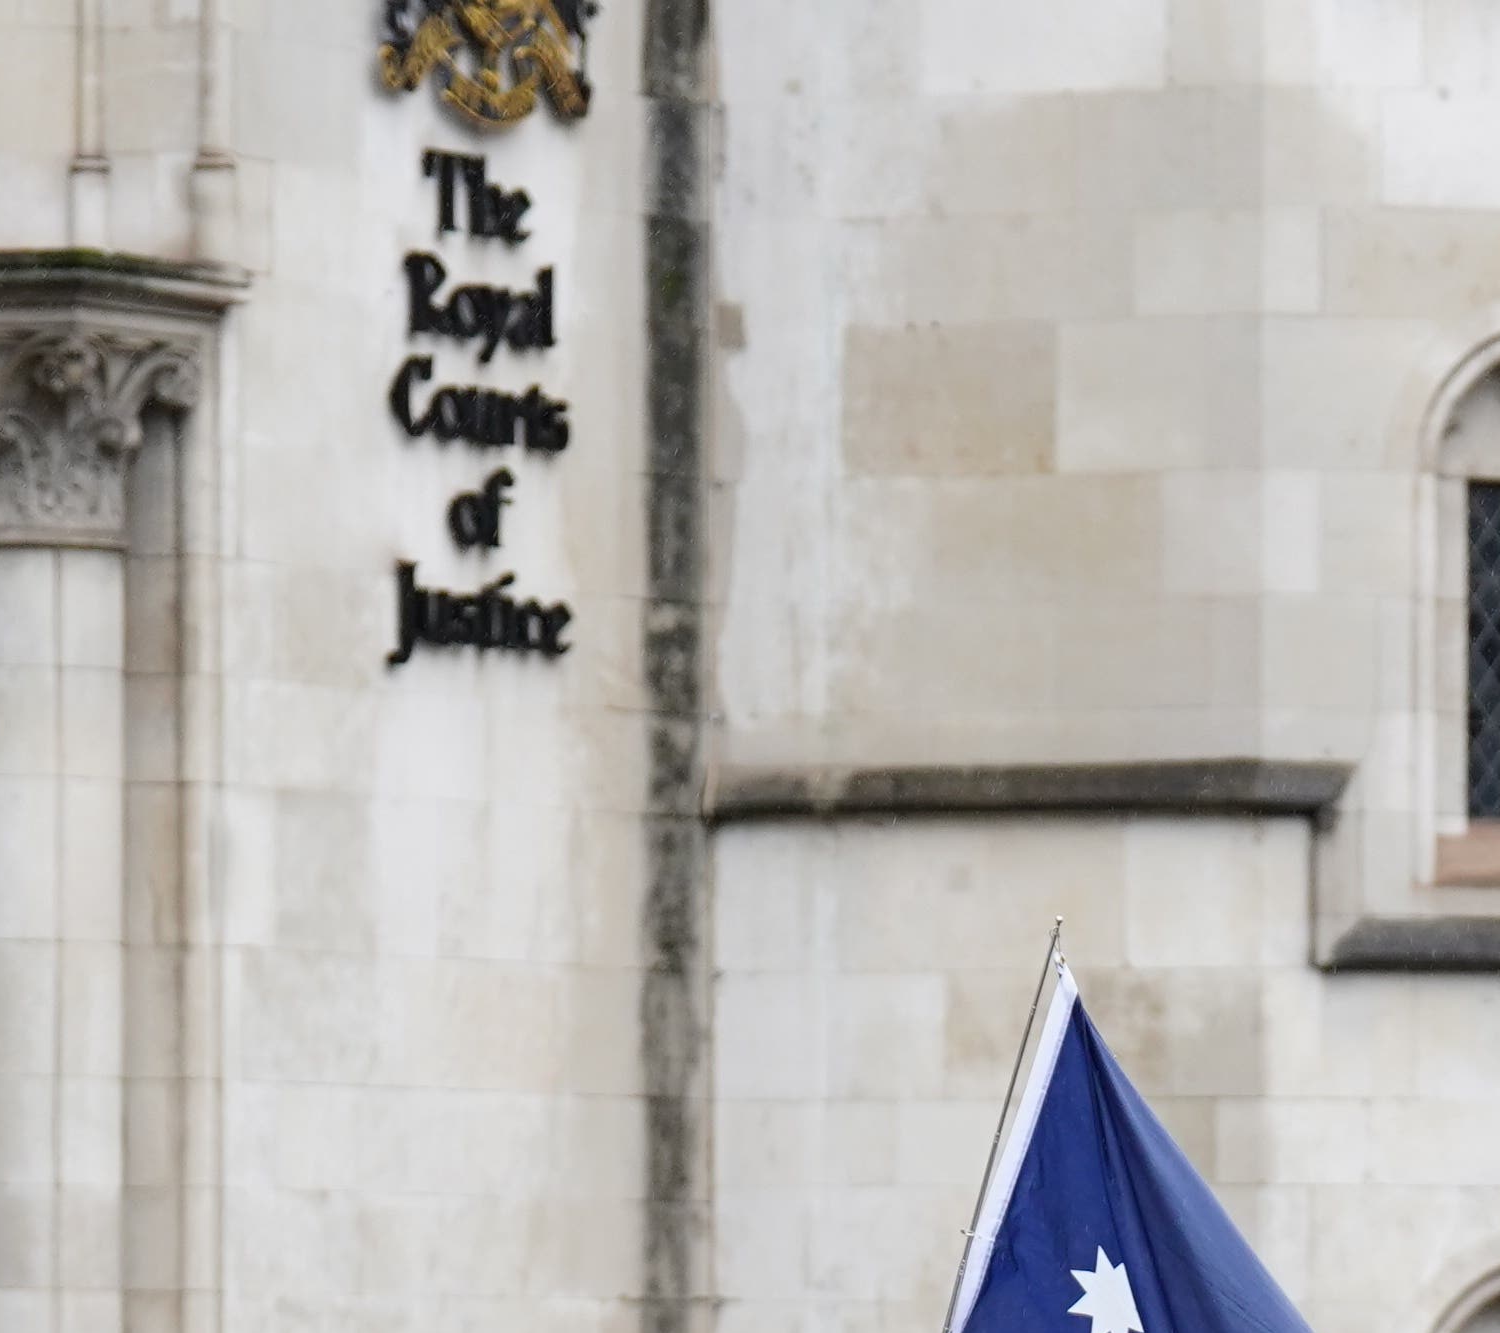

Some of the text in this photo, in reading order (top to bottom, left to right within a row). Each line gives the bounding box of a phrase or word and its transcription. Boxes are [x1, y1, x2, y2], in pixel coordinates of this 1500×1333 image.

[422, 148, 531, 245] The
[403, 251, 556, 362] Royal
[389, 355, 570, 452] Courts
[447, 467, 515, 547] of
[387, 560, 573, 666] Justice
